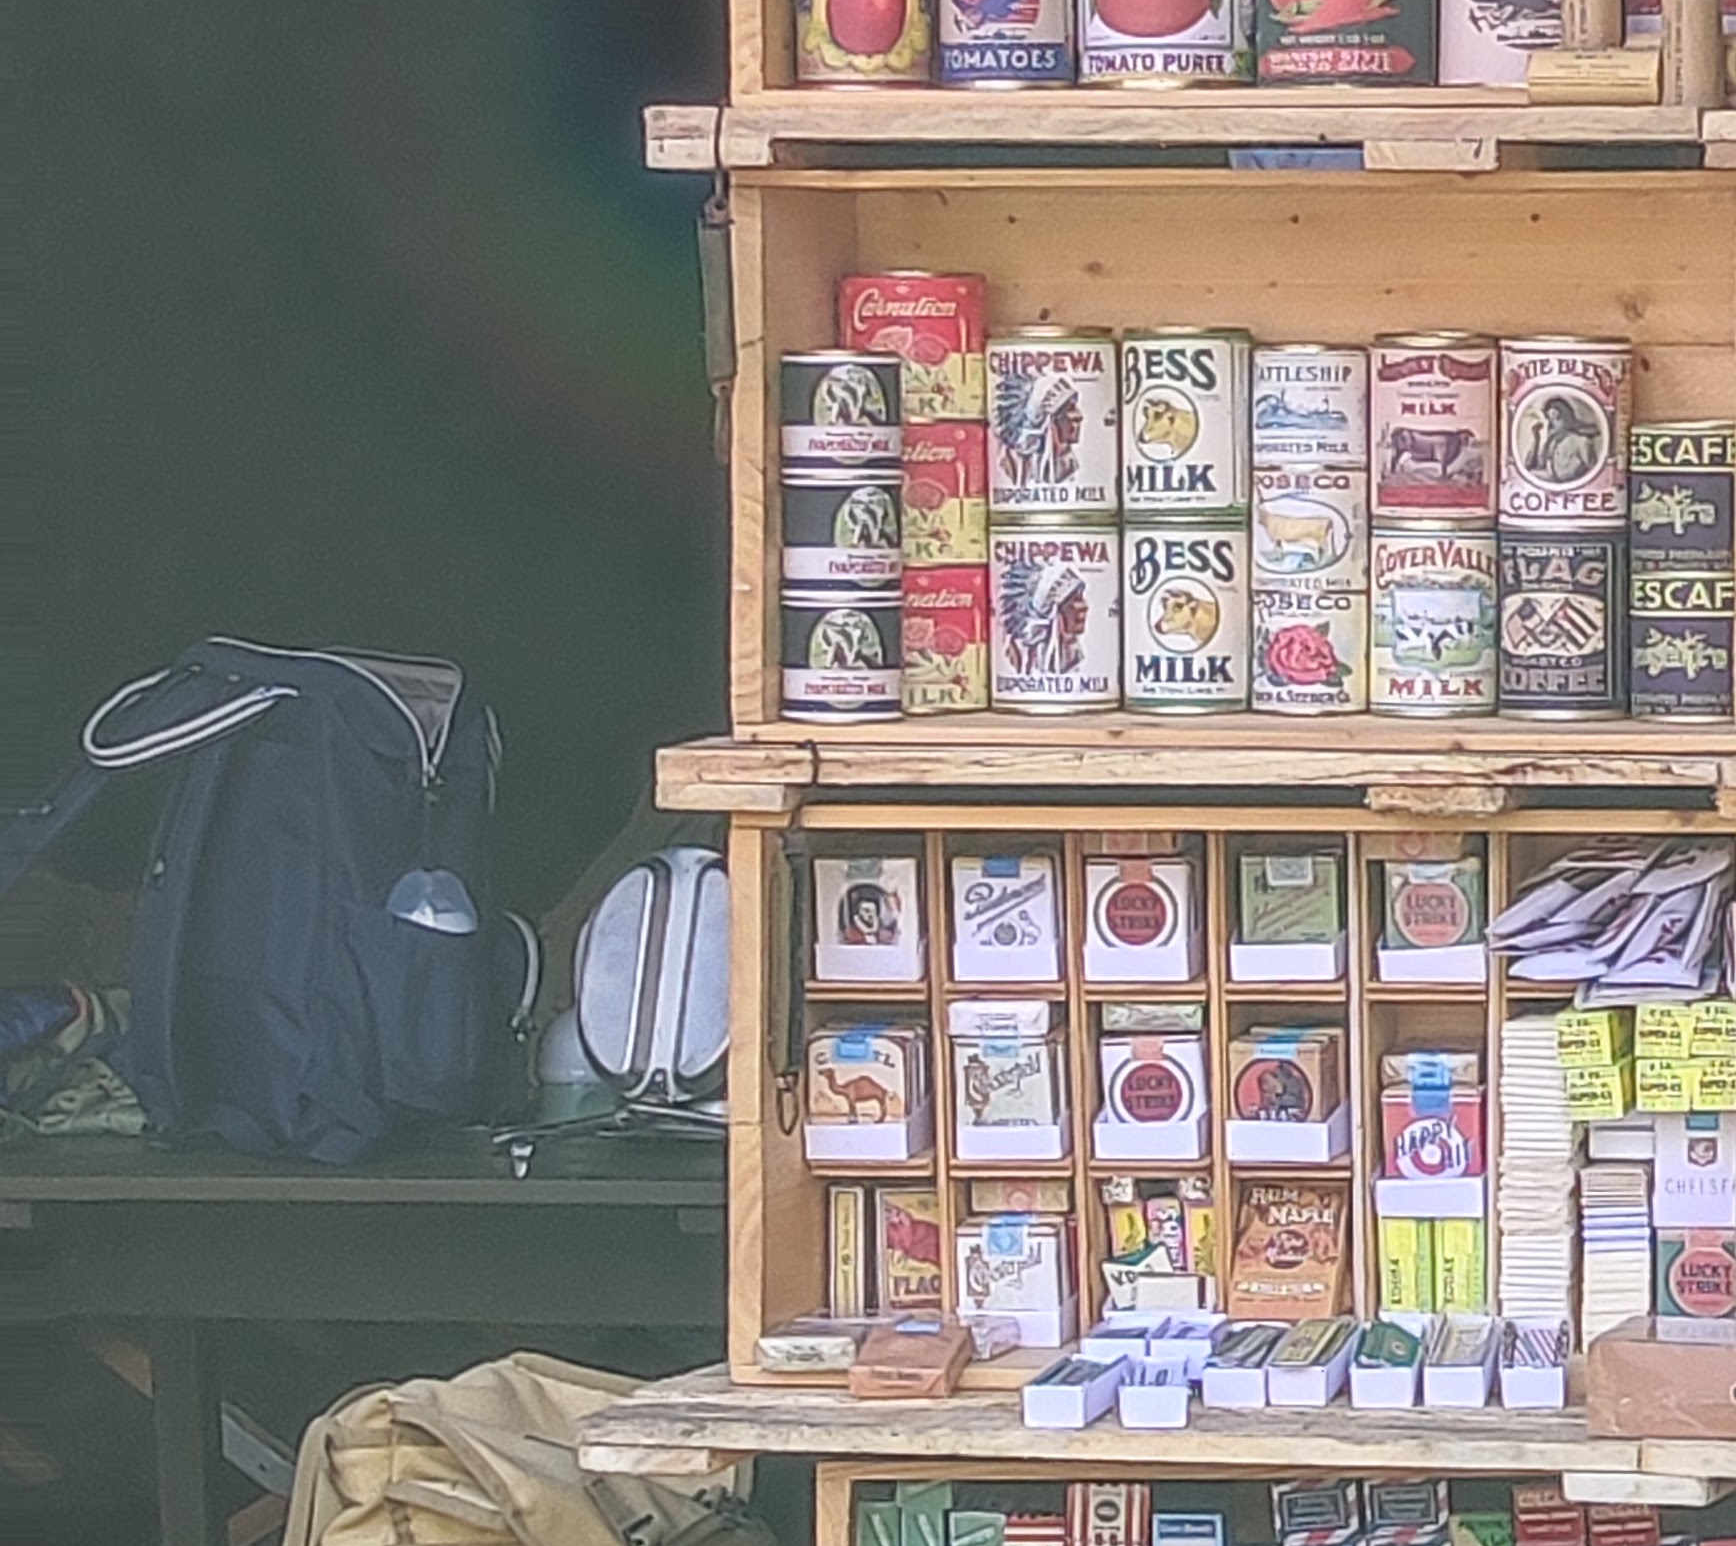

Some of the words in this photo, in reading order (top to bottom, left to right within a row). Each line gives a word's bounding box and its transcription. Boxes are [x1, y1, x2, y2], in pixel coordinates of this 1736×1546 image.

[1161, 53, 1225, 73] PUREE
[853, 287, 957, 330] Carnation
[988, 350, 1105, 374] CHIPPEWA
[1123, 348, 1217, 405] BESS
[1258, 365, 1352, 383] ATTLESHIP
[1400, 401, 1457, 416] MILK
[1632, 436, 1736, 463] SCAF
[1126, 464, 1217, 493] MILK
[1509, 492, 1618, 513] COFFEE
[993, 540, 1110, 566] CHIPPEWA
[1436, 540, 1498, 577] VALLE
[1130, 536, 1236, 595] BESS
[1135, 655, 1236, 684] MILK
[1388, 677, 1484, 698] MILK
[1405, 893, 1457, 911] LUCKY
[1401, 911, 1459, 928] STRIKE
[1251, 1186, 1299, 1205] RUM
[1267, 1206, 1334, 1226] MAPLE
[1680, 1262, 1732, 1278] LUCKY
[1676, 1279, 1734, 1295] STRIKE
